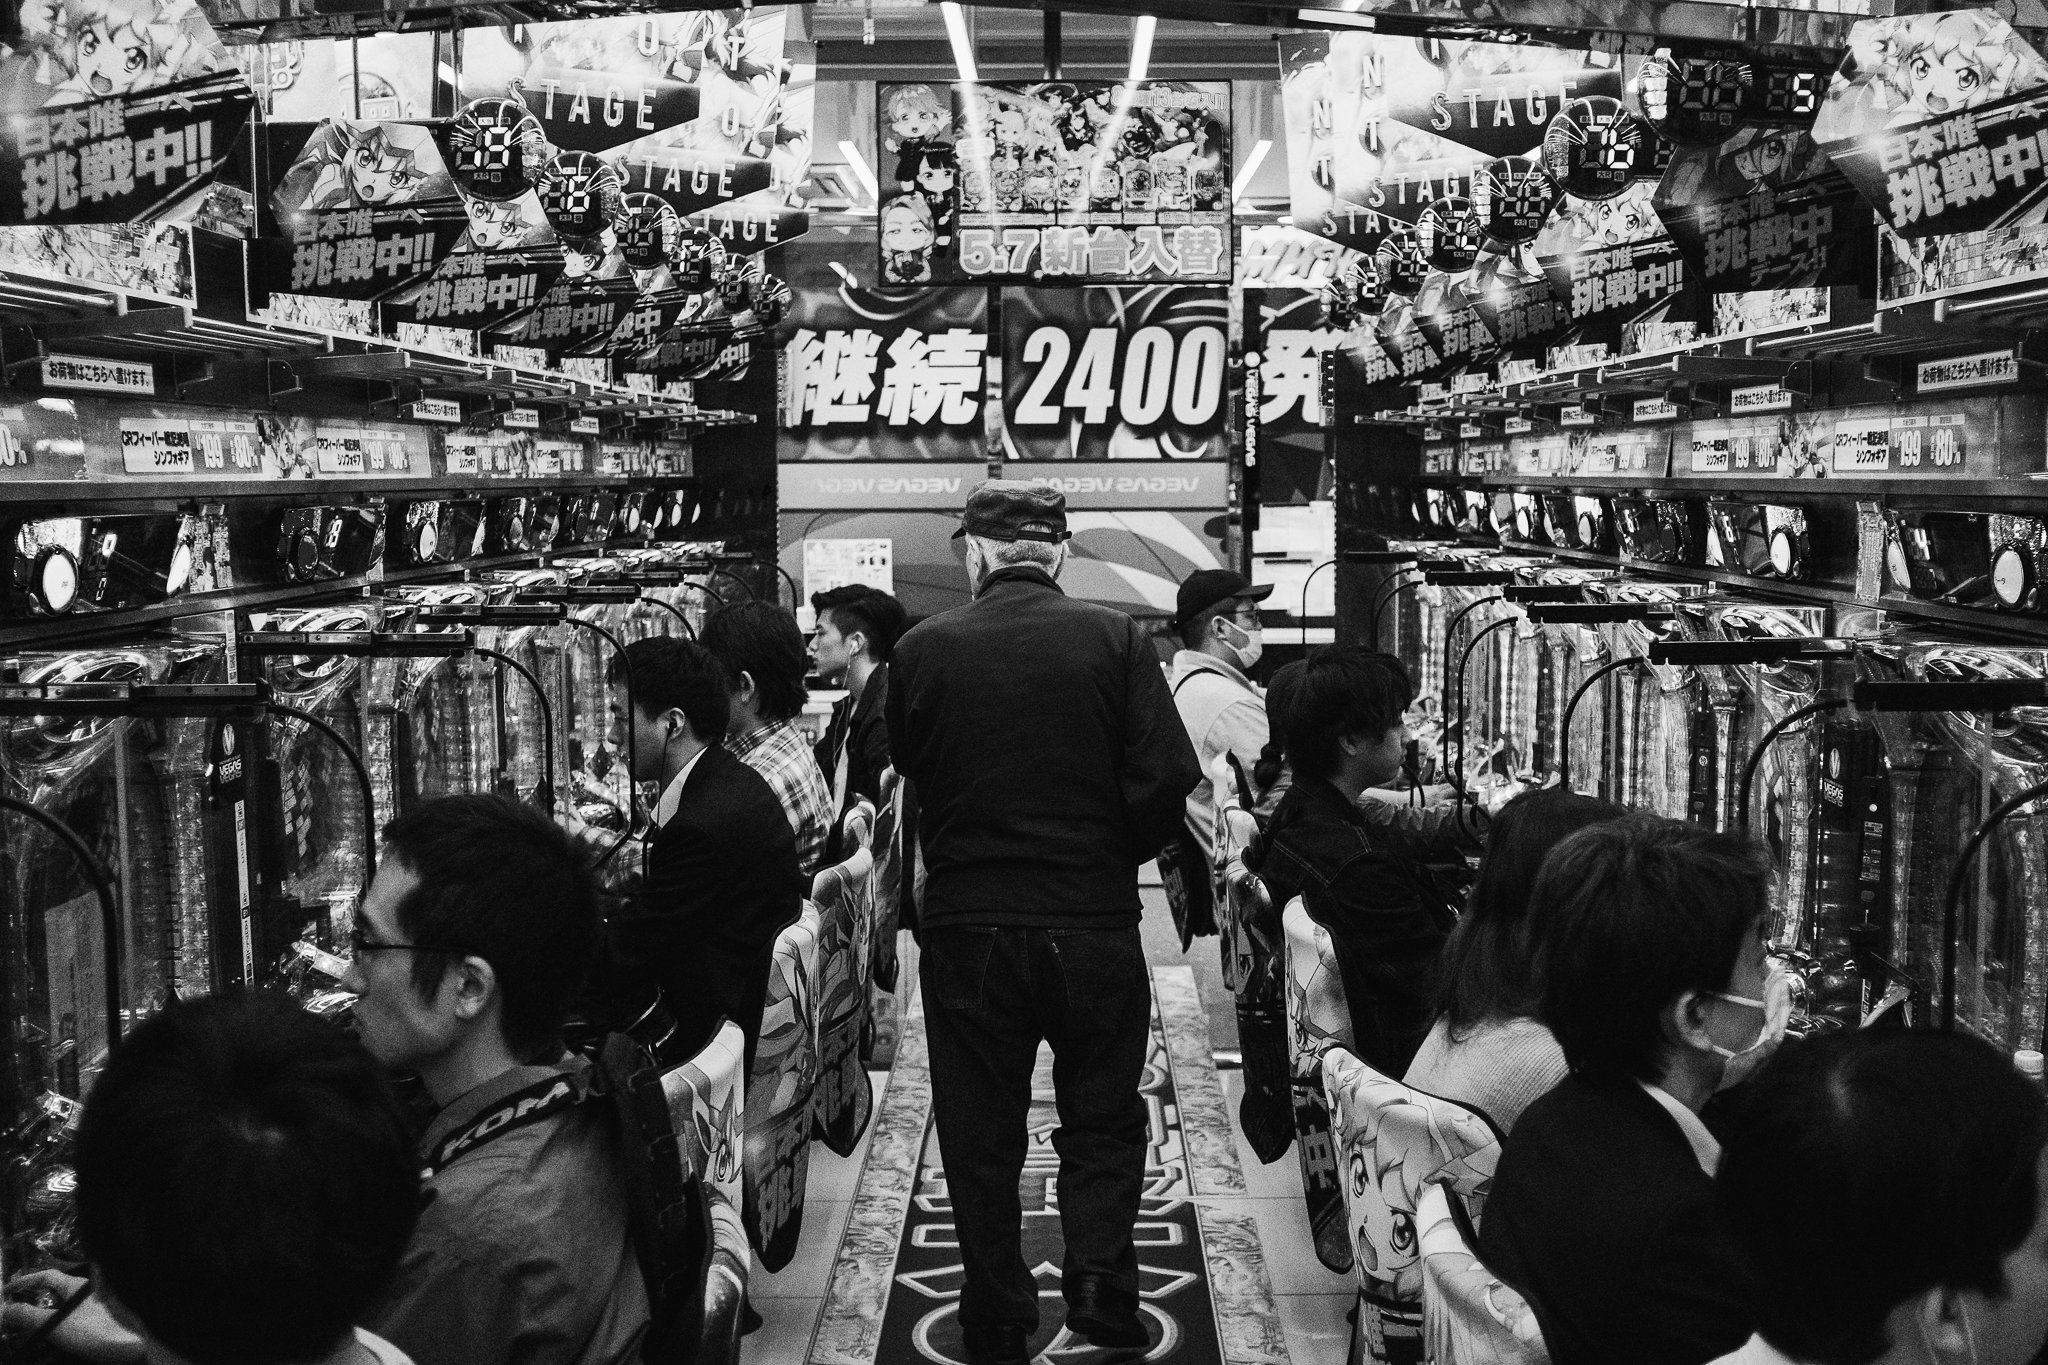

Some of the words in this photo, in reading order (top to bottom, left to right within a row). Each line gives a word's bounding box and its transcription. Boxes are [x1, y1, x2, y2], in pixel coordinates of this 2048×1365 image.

[21, 120, 212, 220] 挑戦中!!
[614, 153, 736, 198] STAGE
[290, 232, 436, 291] 挑戦中!!
[416, 273, 538, 321] 挑戦中!!
[1571, 259, 1684, 319] 挑戦中!!
[785, 327, 988, 428] 継続
[1014, 326, 1224, 425] 2400
[0, 423, 28, 466] 0%
[154, 450, 189, 466] シンフォギア
[1856, 448, 1886, 463] シンフォギア
